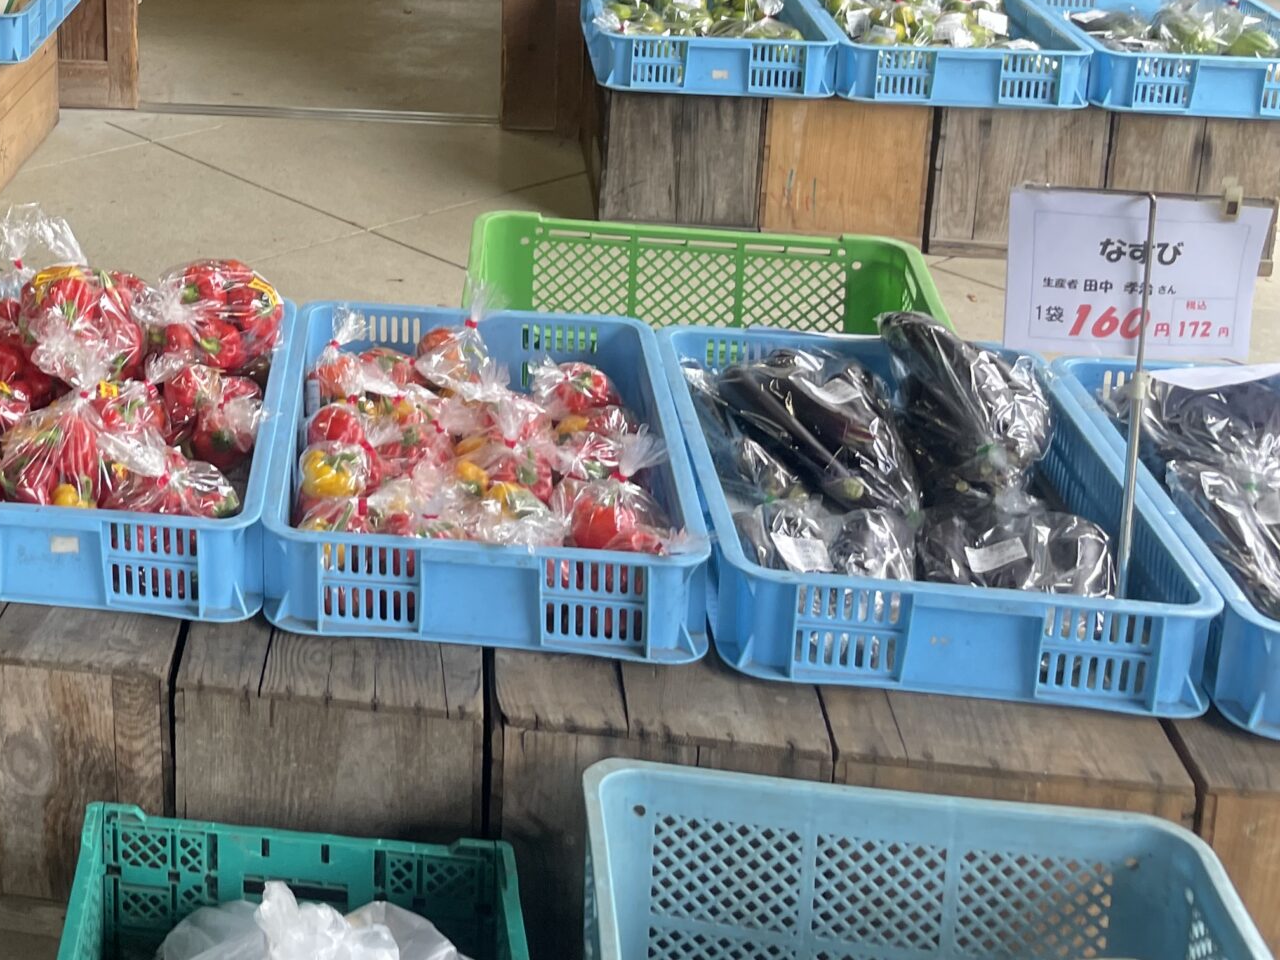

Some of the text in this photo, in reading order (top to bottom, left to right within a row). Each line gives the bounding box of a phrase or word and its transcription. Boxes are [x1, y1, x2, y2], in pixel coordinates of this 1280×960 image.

[1098, 237, 1184, 266] なすび
[1042, 276, 1079, 290] 生産者
[1083, 278, 1114, 293] 田中
[1157, 284, 1177, 295] さん
[1034, 304, 1065, 324] 1袋
